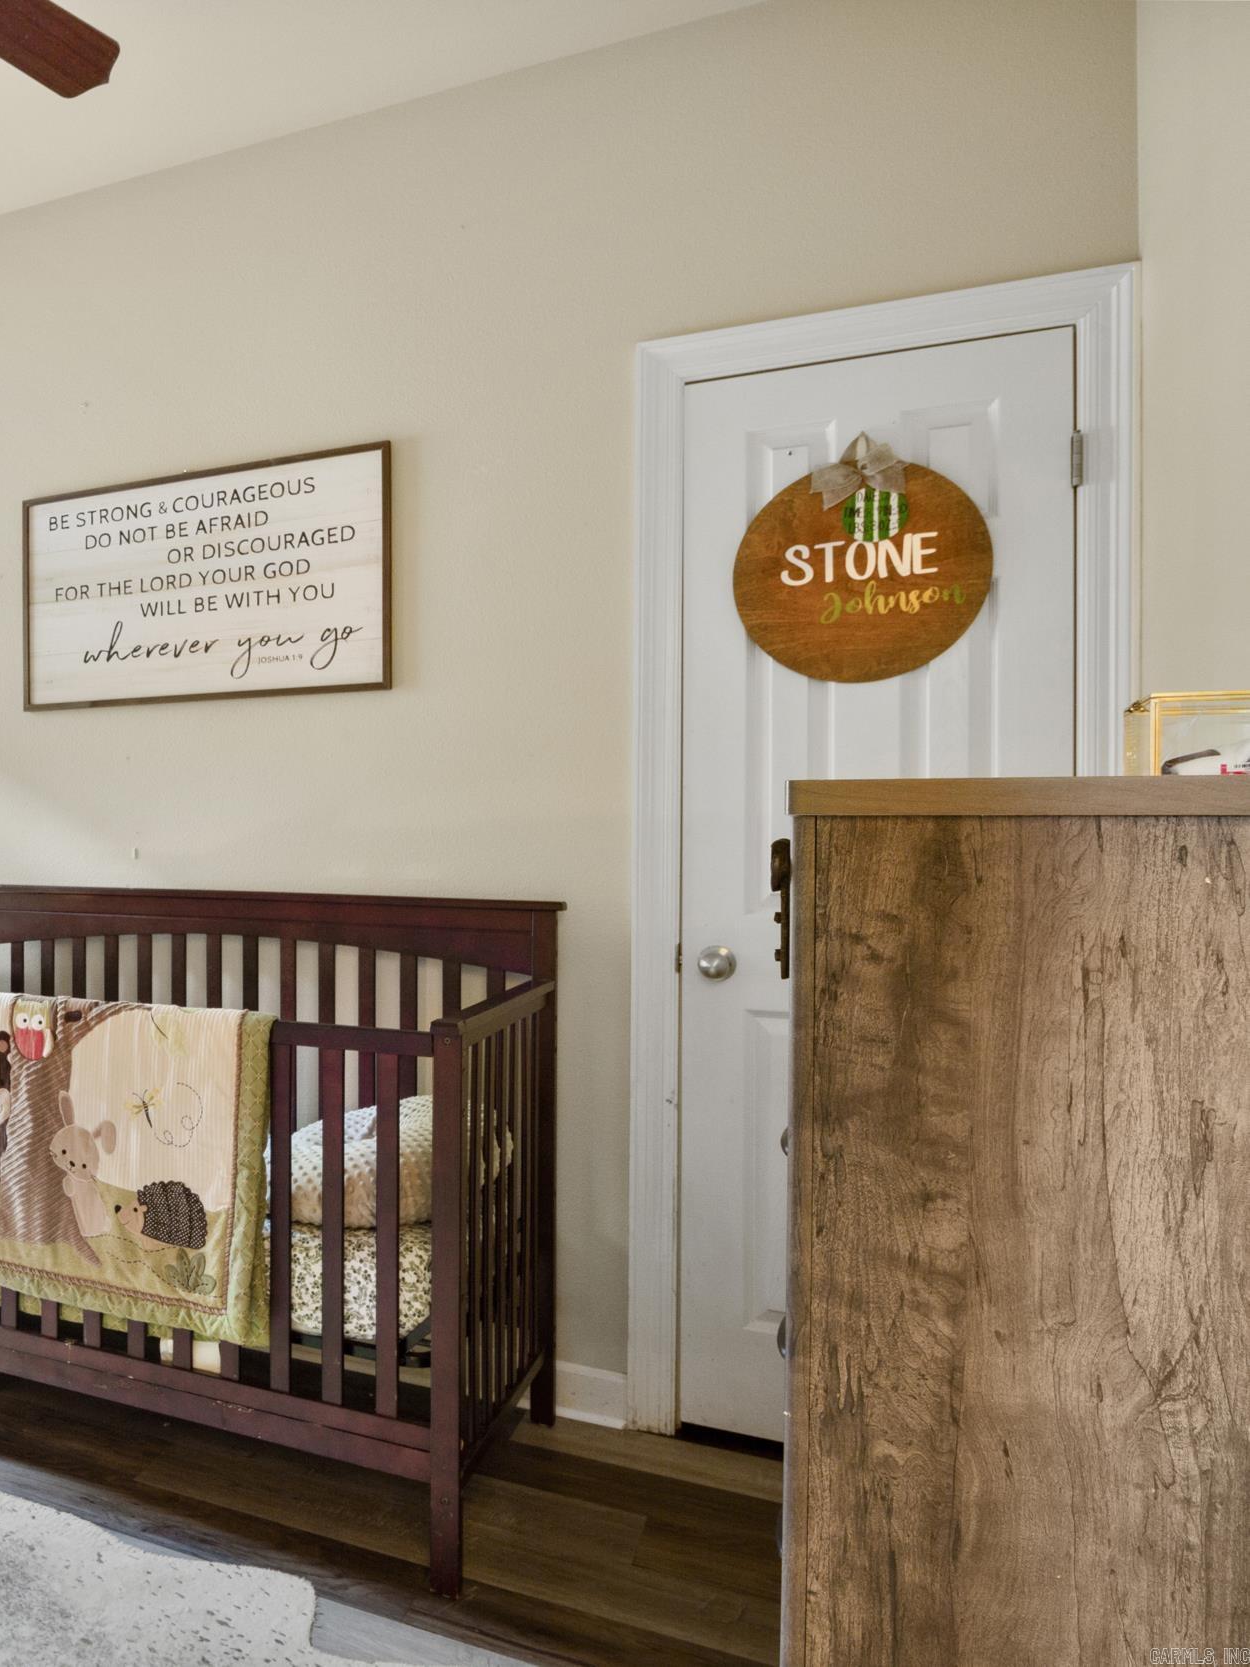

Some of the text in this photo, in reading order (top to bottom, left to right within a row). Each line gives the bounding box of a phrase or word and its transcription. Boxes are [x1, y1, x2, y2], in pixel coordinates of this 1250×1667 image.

[48, 476, 316, 532] BE STRONG & COURAGEOUS
[85, 510, 269, 551] DO NOT BE AFRAID
[167, 524, 356, 565] OR DISCOURAGED
[55, 558, 311, 603] FOR THE LORD YOUR GOD
[780, 531, 939, 587] STONE
[139, 582, 335, 618] WILL BE WITH YOU
[818, 580, 967, 625] Johnson
[83, 621, 364, 680] wherever you go
[257, 655, 290, 664] JOSHUA
